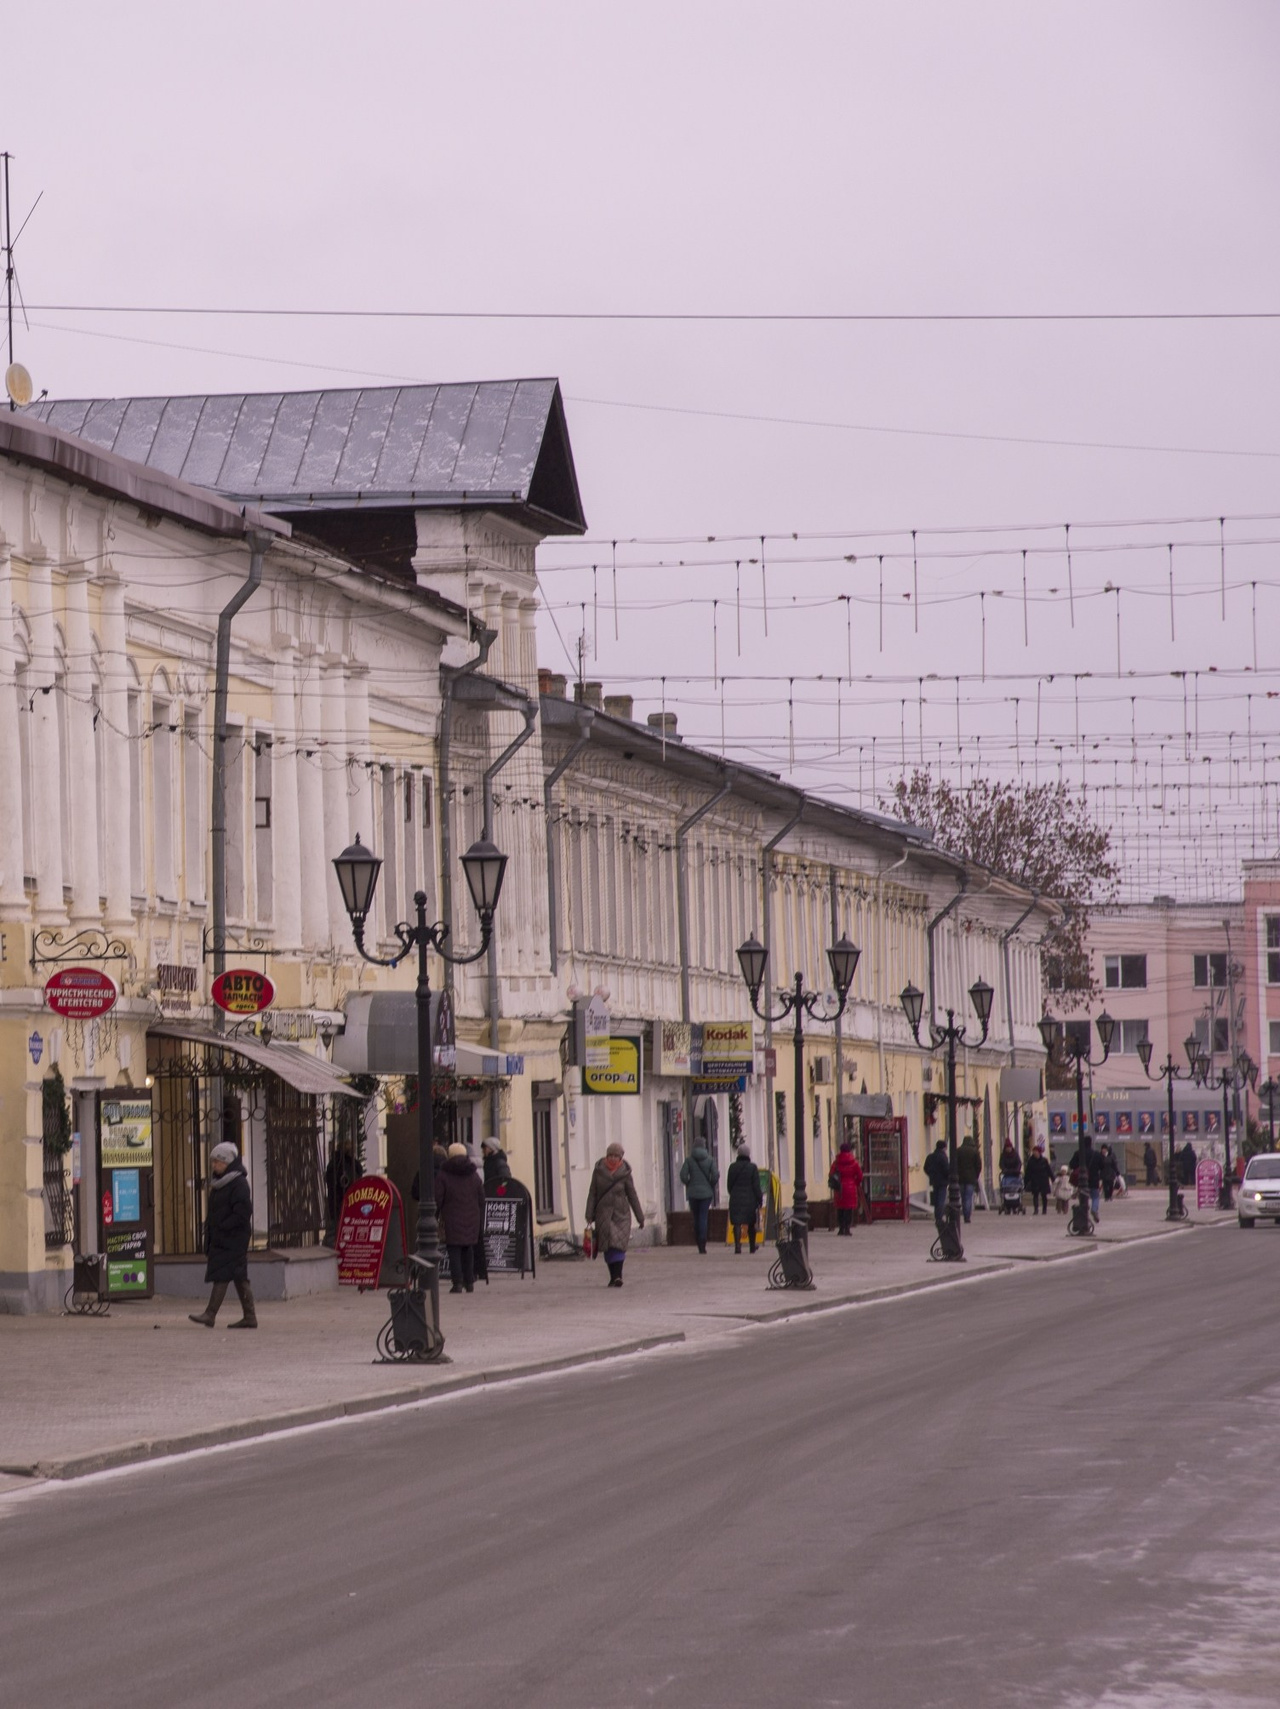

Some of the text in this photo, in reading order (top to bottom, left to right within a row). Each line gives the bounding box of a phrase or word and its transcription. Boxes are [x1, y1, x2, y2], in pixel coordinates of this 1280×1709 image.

[222, 975, 264, 992] АВТО
[47, 988, 114, 998] ТУРИСТИЧЕСКОЕ
[223, 992, 263, 1002] ЗАПЧАСТИ
[58, 998, 103, 1007] АГЕНТСТВО
[706, 1029, 749, 1040] Kodak
[348, 1187, 389, 1210] ЛОМБАРД
[488, 1203, 510, 1211] КОФЕ
[132, 1230, 147, 1240] СВОЙ
